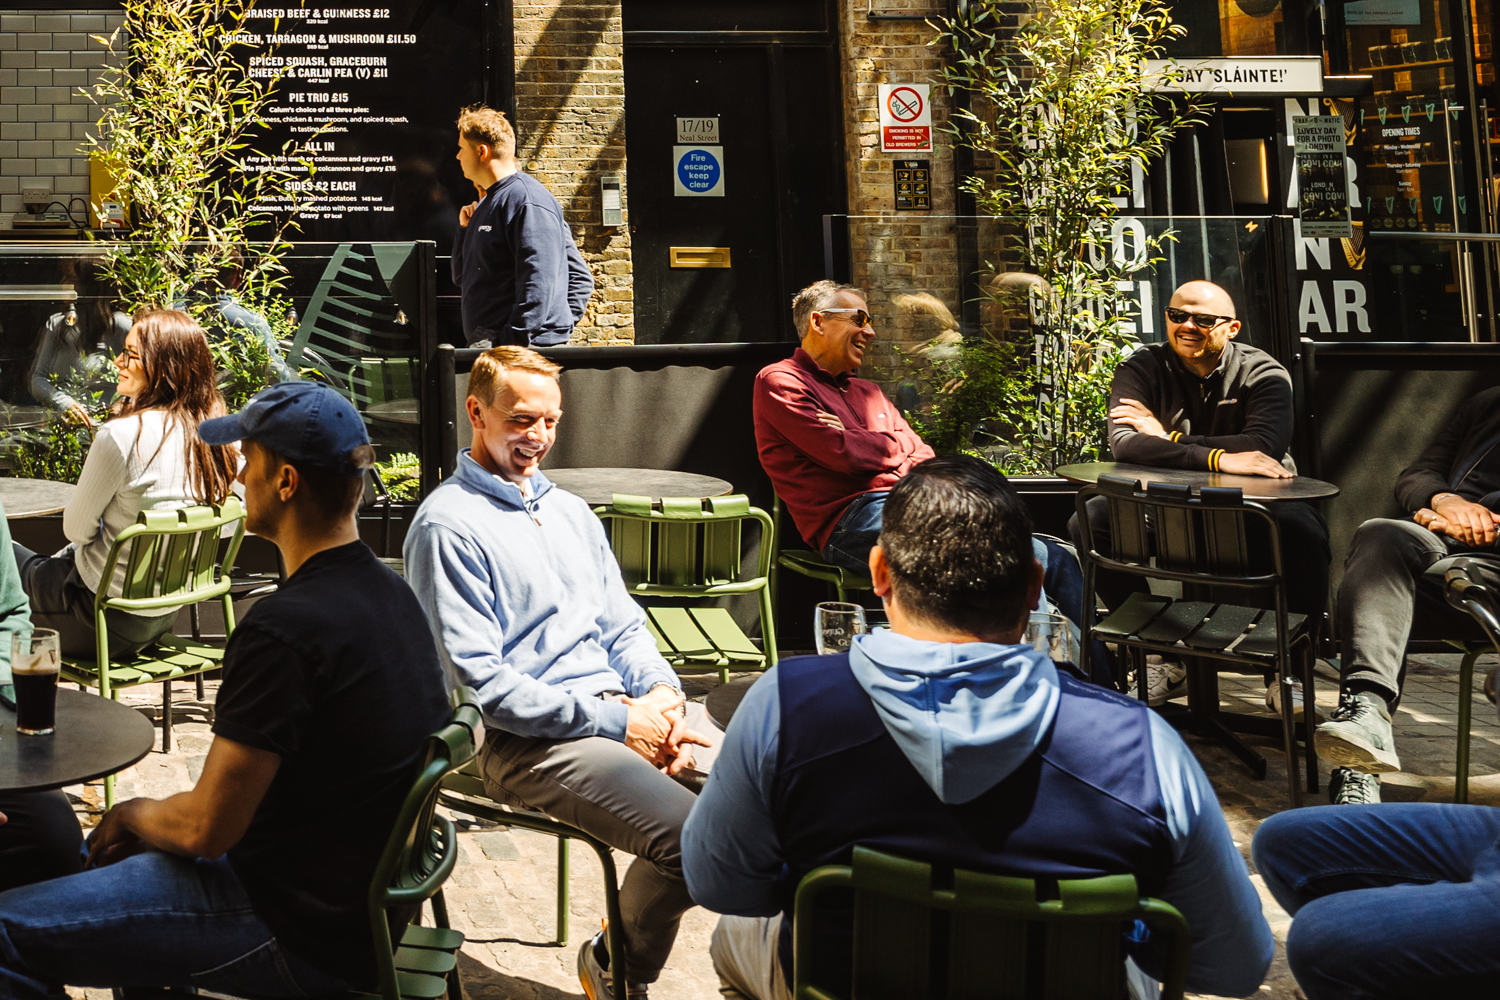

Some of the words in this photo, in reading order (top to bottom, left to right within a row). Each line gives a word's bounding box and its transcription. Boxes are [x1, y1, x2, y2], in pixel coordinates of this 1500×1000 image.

[246, 8, 285, 18] BRAISED
[287, 8, 311, 18] BEEF
[312, 8, 321, 18] &
[323, 8, 371, 18] GUINNESS
[372, 8, 390, 18] £12
[266, 34, 316, 44] TARRAGON
[318, 34, 327, 44] &
[328, 34, 384, 44] MUSHROOM
[386, 34, 416, 44] £11.50
[250, 57, 284, 66] SPICED
[286, 57, 328, 67] SQUASH,
[330, 57, 387, 66] GRACEBURN
[288, 68, 296, 77] &
[298, 68, 332, 77] CARLIN
[334, 68, 353, 77] PEA
[355, 68, 371, 79] (V)
[373, 68, 388, 77] £11
[1176, 70, 1204, 83] SAY
[289, 93, 305, 103] PIE
[307, 93, 329, 103] TRIO
[331, 93, 349, 103] £15
[385, 116, 409, 124] squash,
[682, 120, 714, 132] 17/19
[1382, 128, 1404, 137] OPENING
[1404, 127, 1420, 135] TIMES
[305, 142, 322, 151] ALL
[324, 142, 335, 151] IN
[285, 182, 313, 191] SIDES
[315, 182, 329, 191] £2
[330, 182, 356, 191] EACH
